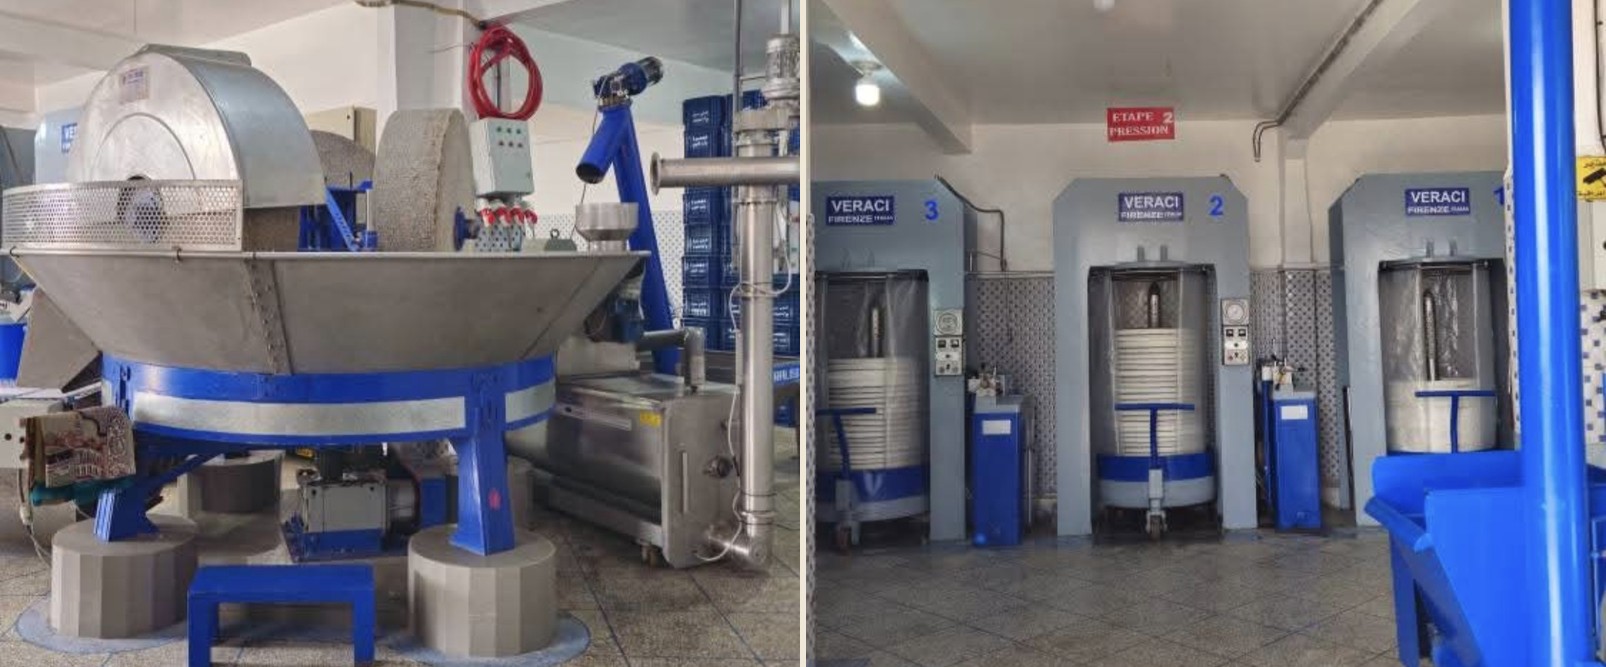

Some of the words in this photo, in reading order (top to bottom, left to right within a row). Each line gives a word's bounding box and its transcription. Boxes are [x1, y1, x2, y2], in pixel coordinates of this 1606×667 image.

[1112, 111, 1154, 122] ETAPE
[1162, 111, 1173, 124] 2
[1109, 126, 1169, 136] PRESSION
[1124, 195, 1179, 209] VERACI
[1410, 190, 1466, 203] VERACI
[831, 199, 890, 212] VERACI
[925, 200, 939, 220] 3
[1208, 195, 1224, 216] 2
[1408, 205, 1450, 214] FIRENZE
[828, 215, 873, 223] FIRENZE
[1121, 211, 1164, 219] FIRENZE
